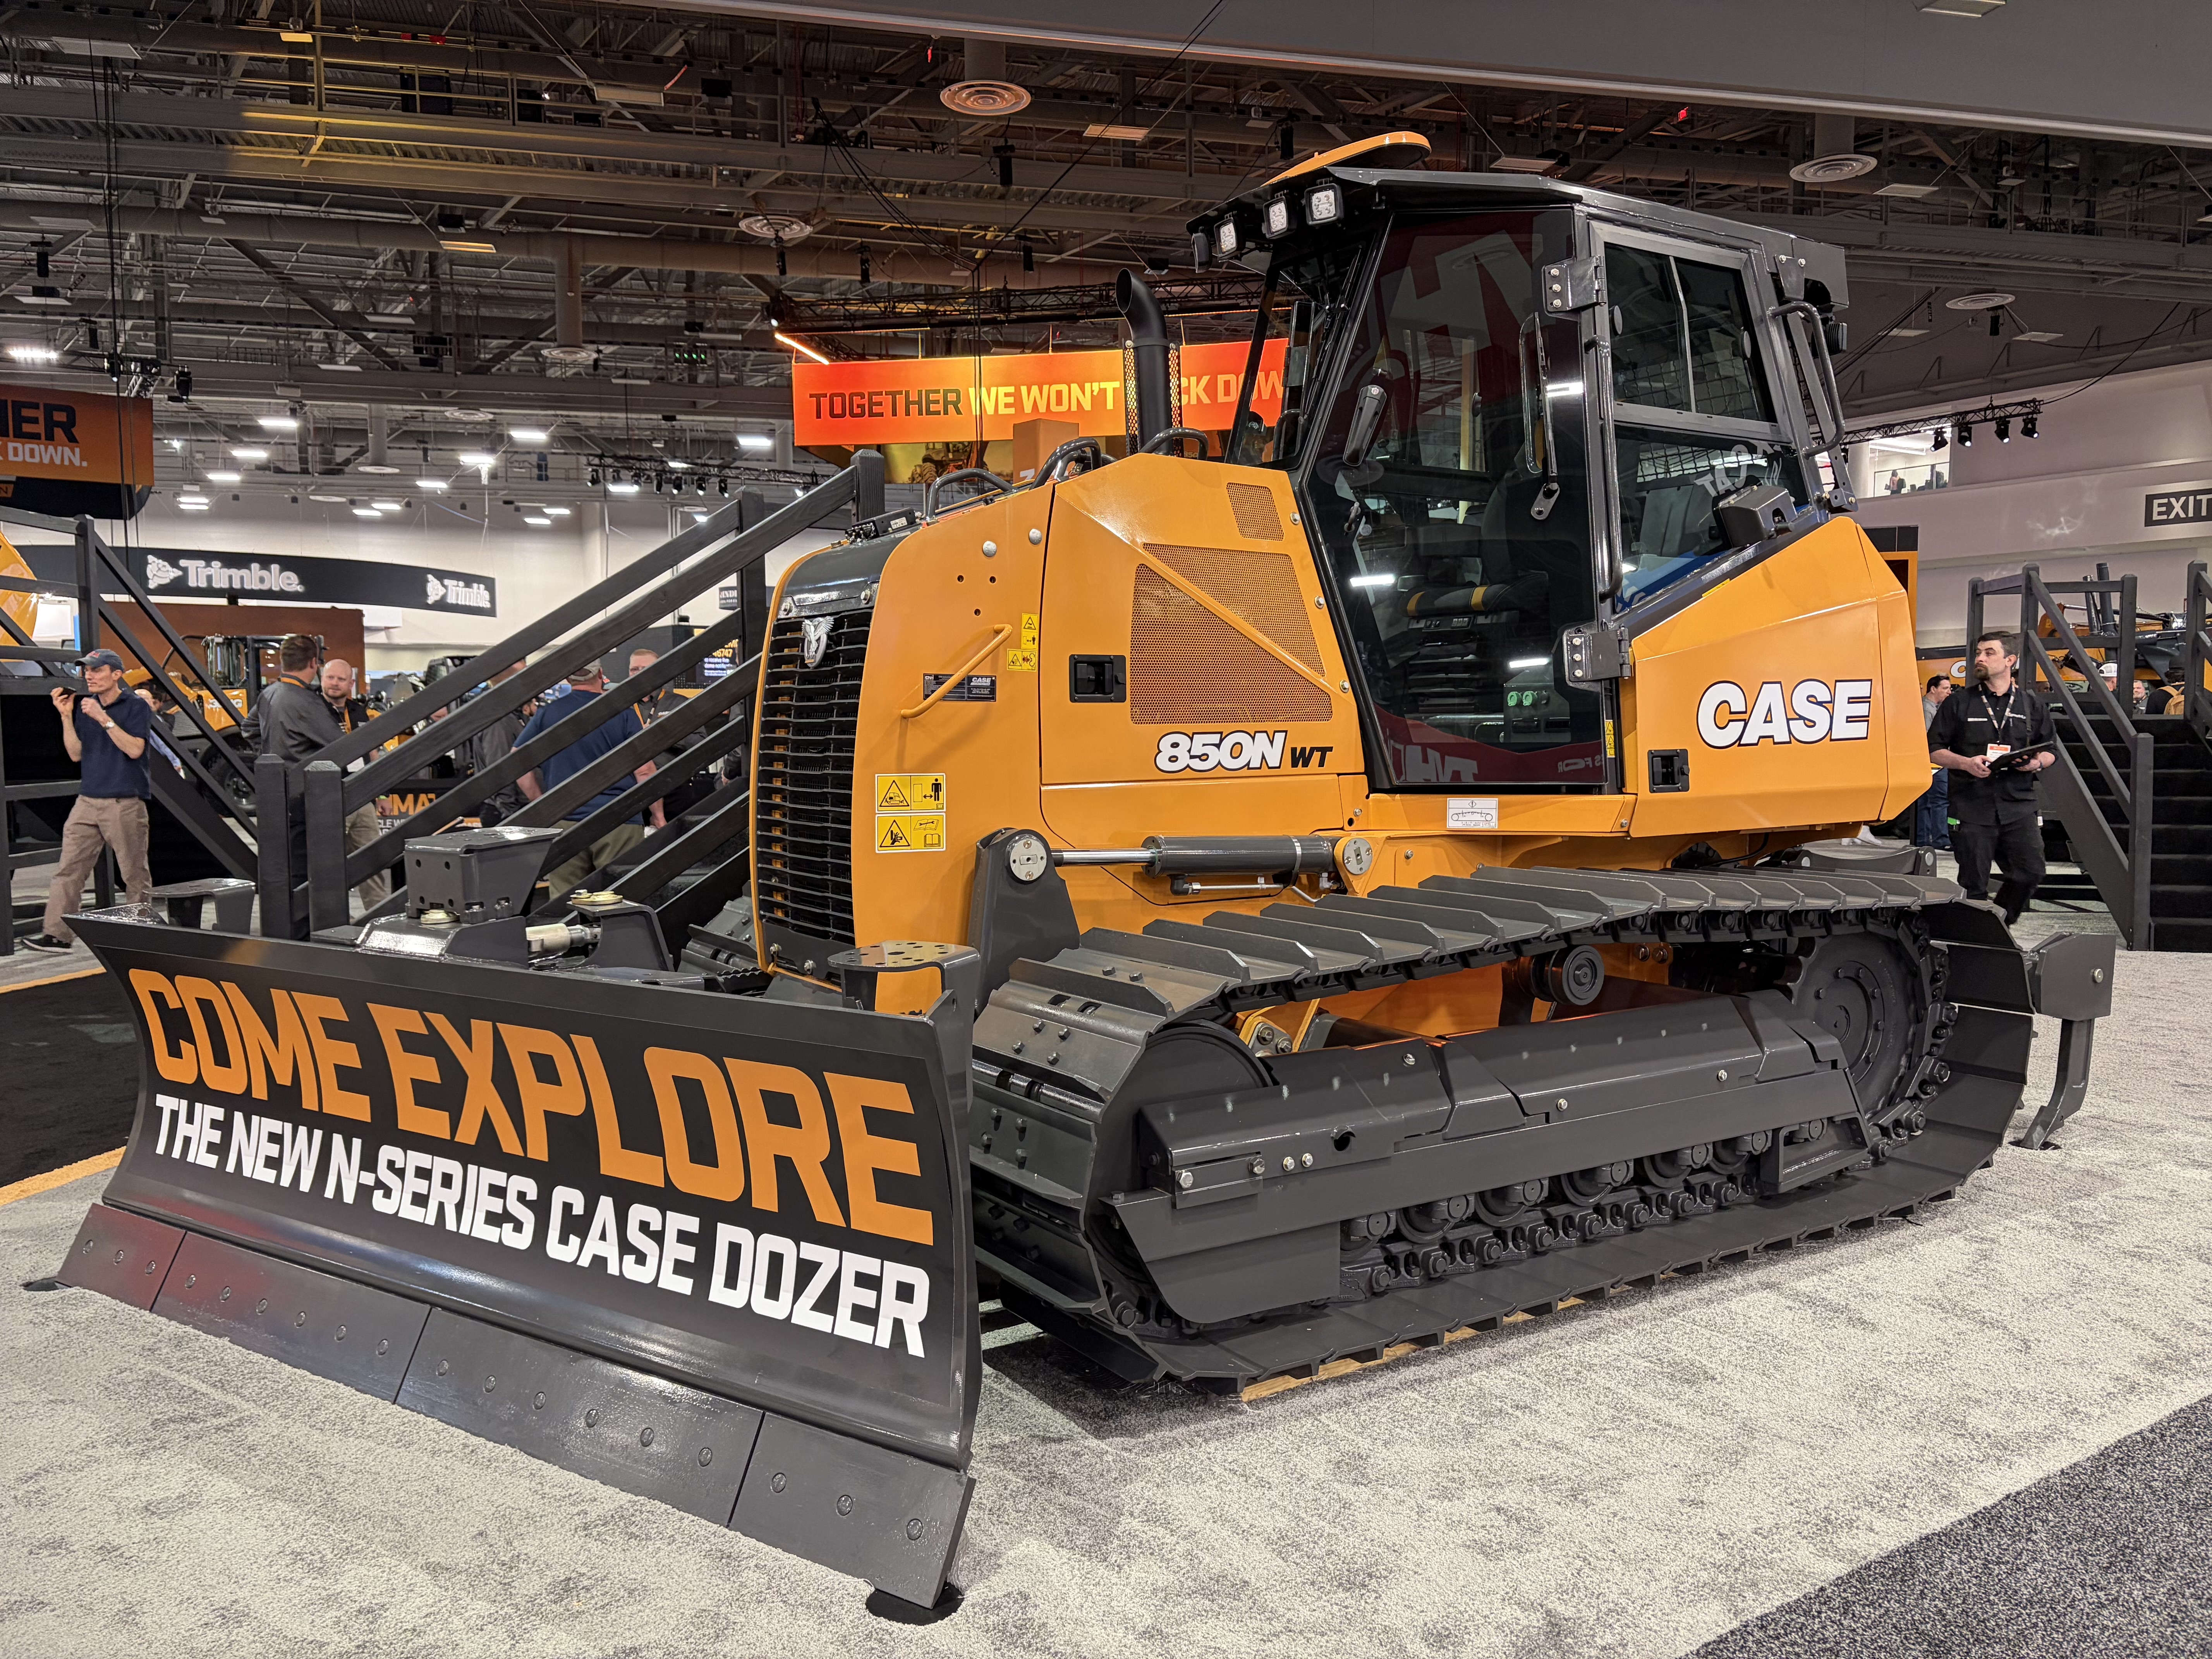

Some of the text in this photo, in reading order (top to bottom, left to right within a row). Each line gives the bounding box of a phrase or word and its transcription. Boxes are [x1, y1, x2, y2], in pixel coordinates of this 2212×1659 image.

[809, 389, 963, 419] TOGETHER
[969, 386, 1015, 415] WE
[1020, 381, 1120, 413] WON'T
[1173, 374, 1211, 405] CK
[7, 442, 87, 467] DOWN.
[2152, 494, 2212, 520] EXIT
[1697, 678, 1872, 749] CASE
[1154, 730, 1333, 773] 850N WT
[129, 969, 934, 1246] COME EXPLORE
[155, 1093, 929, 1358] THE NEW N-SERIES CASE DOZER
